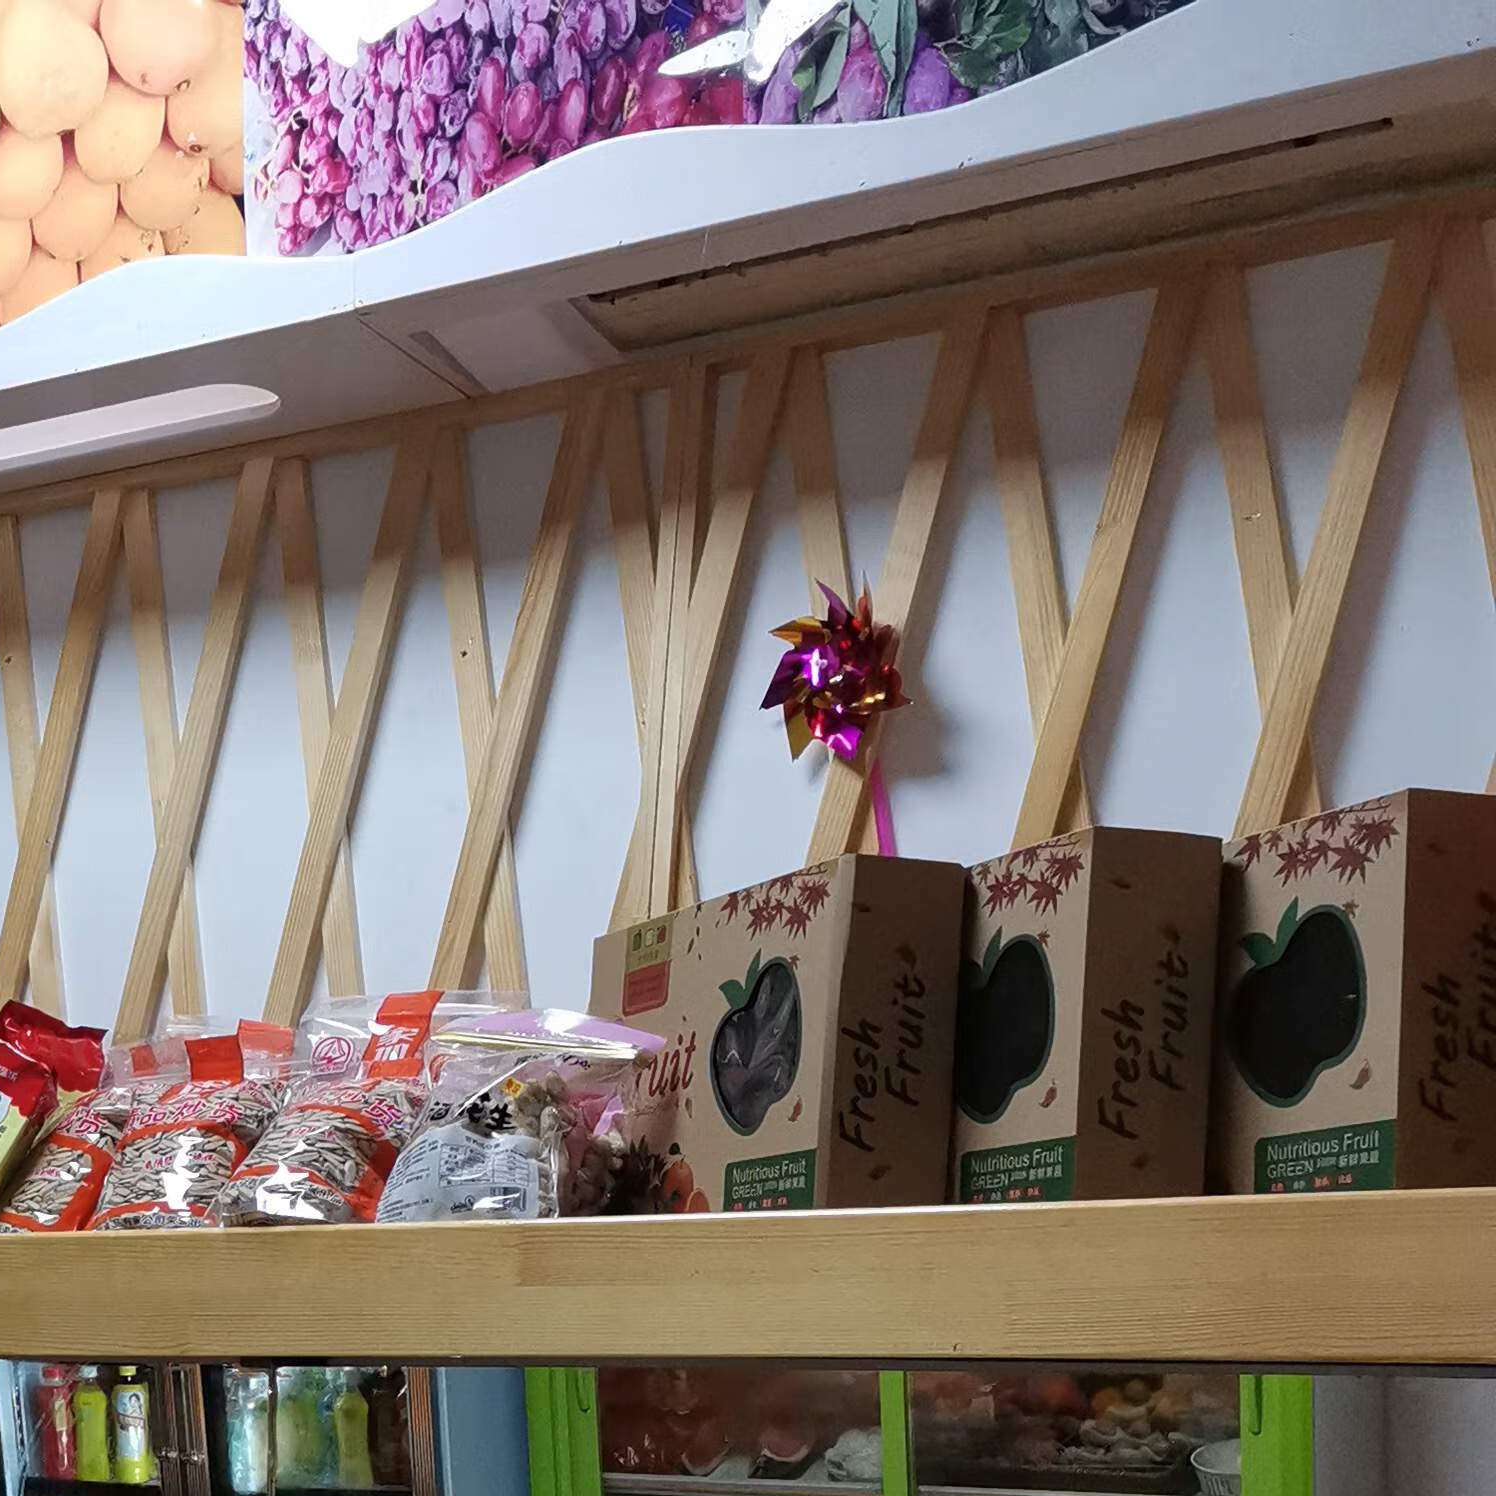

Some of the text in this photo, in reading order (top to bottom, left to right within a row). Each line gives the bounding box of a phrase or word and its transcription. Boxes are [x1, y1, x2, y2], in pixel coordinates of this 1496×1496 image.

[1149, 951, 1190, 1092] Fruit
[884, 971, 926, 1107] Fruit
[1419, 971, 1462, 1122] Fresh
[839, 1016, 882, 1152] Fresh
[1096, 998, 1144, 1140] Fresh
[970, 1145, 1064, 1174] Nutritious Fruit
[1266, 1139, 1340, 1162] Nutritious
[1342, 1129, 1380, 1152] Fruit
[732, 1157, 807, 1183] Nutritious Fruit
[970, 1171, 1009, 1190] GREEN
[1266, 1158, 1314, 1179] GREEN
[731, 1182, 764, 1200] GREEN
